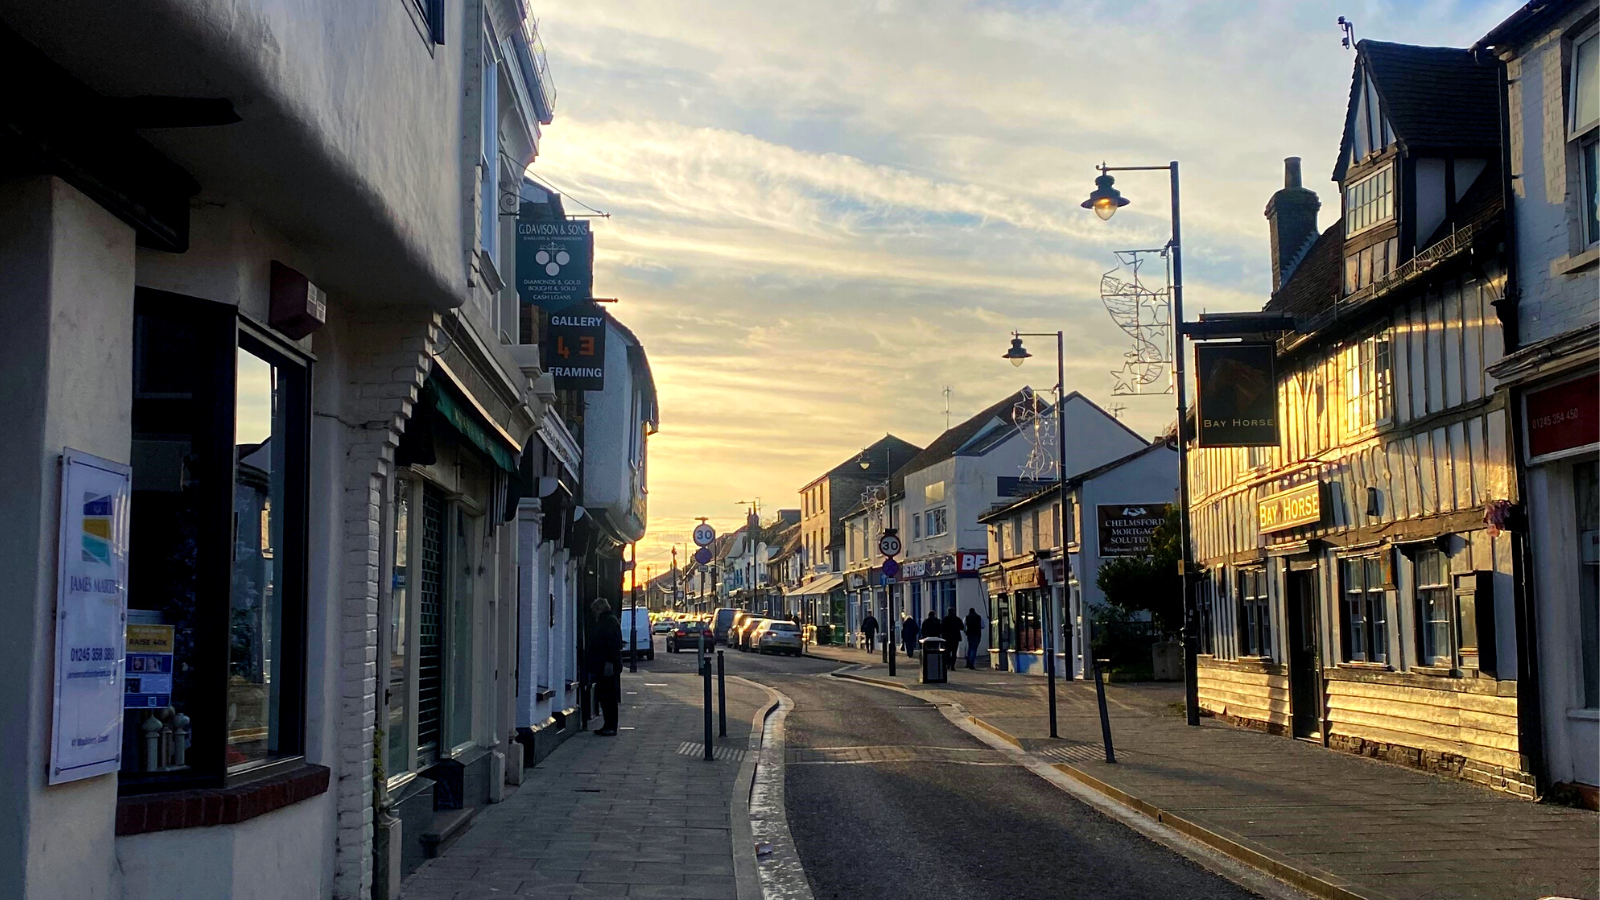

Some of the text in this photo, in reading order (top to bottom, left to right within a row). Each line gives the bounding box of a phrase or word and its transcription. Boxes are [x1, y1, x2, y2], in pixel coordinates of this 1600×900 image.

[561, 224, 566, 235] &
[567, 224, 588, 235] SONS
[551, 315, 602, 327] GALLERY
[548, 366, 602, 378] FRAMING
[1204, 418, 1274, 428] BAY HORSE
[1532, 415, 1552, 429] 01245
[1259, 494, 1319, 527] BAY HORSE
[1105, 518, 1165, 527] CHELMSFORD
[696, 530, 713, 540] 30
[1111, 527, 1155, 536] MORTGAG
[882, 541, 898, 550] 30
[70, 576, 92, 595] JAMES
[70, 647, 91, 662] 01245
